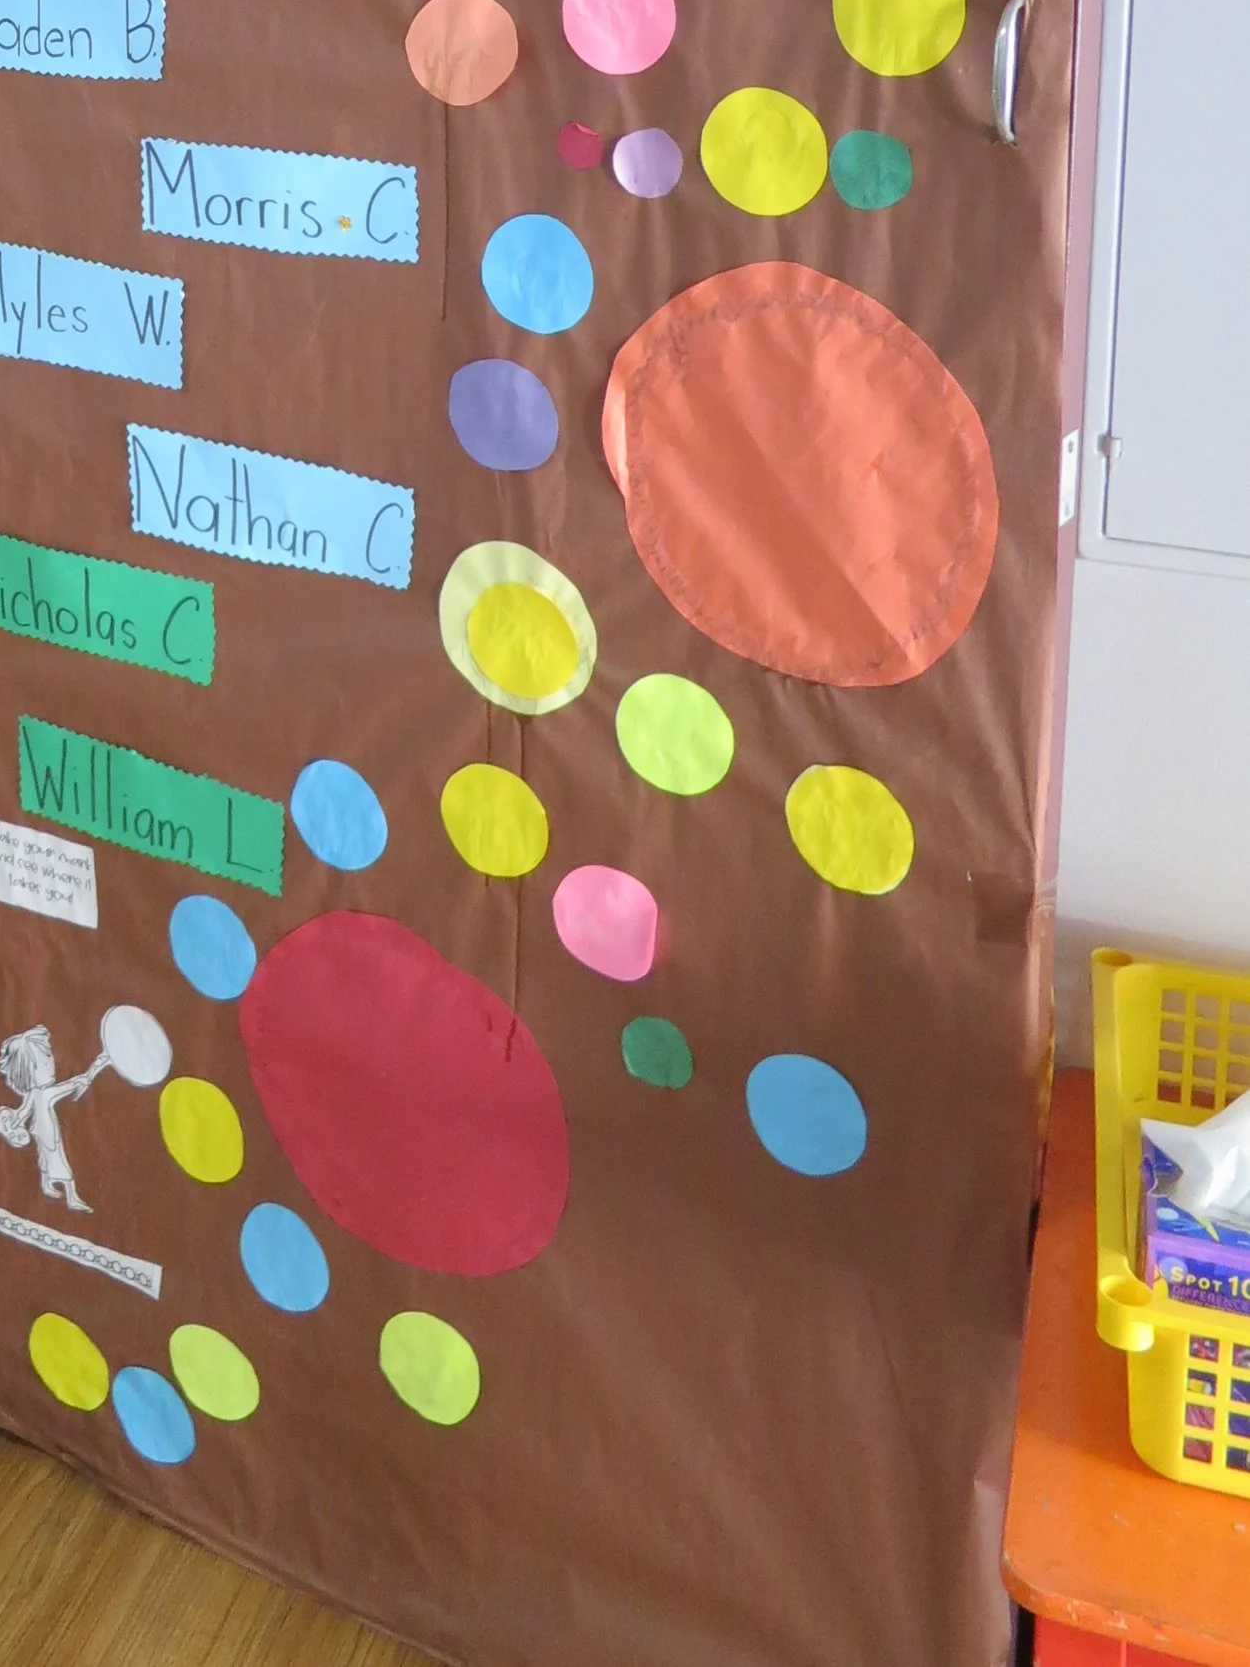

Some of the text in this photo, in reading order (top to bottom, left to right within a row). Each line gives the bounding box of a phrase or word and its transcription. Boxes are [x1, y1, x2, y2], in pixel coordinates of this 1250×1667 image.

[146, 142, 322, 238] Morris
[124, 282, 171, 346] W.
[132, 435, 328, 564] Nathan
[22, 725, 194, 859] William
